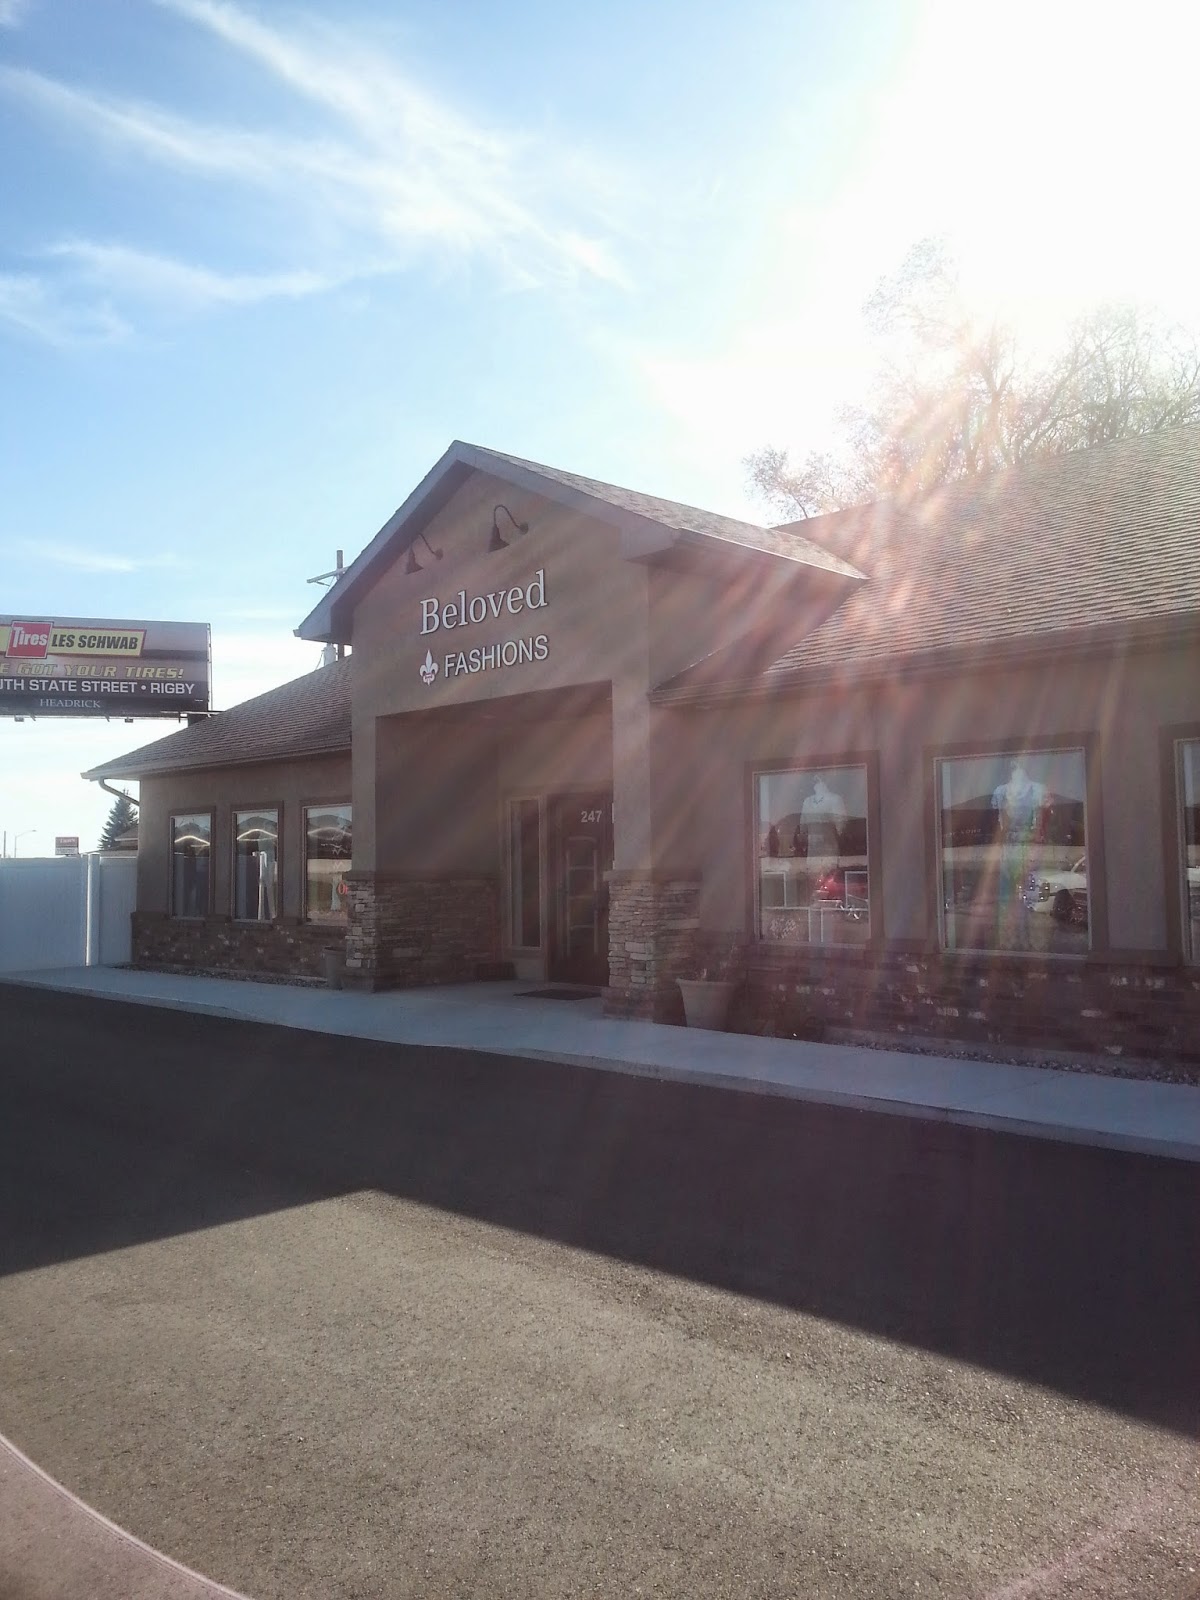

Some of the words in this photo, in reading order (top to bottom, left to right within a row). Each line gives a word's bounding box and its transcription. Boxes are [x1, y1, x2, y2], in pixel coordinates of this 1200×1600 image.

[419, 568, 548, 635] Beloved
[13, 626, 48, 648] Tires
[51, 634, 75, 648] LES
[77, 635, 139, 650] SCHWAB
[444, 634, 548, 678] FASHIONS
[17, 662, 57, 676] GOT
[64, 664, 116, 677] YOUR
[125, 665, 184, 679] TIRES!
[29, 679, 77, 692] STATE
[81, 680, 138, 694] STREET
[150, 682, 195, 695] RIGBY
[40, 698, 101, 709] HEADRICK
[580, 809, 602, 823] 247
